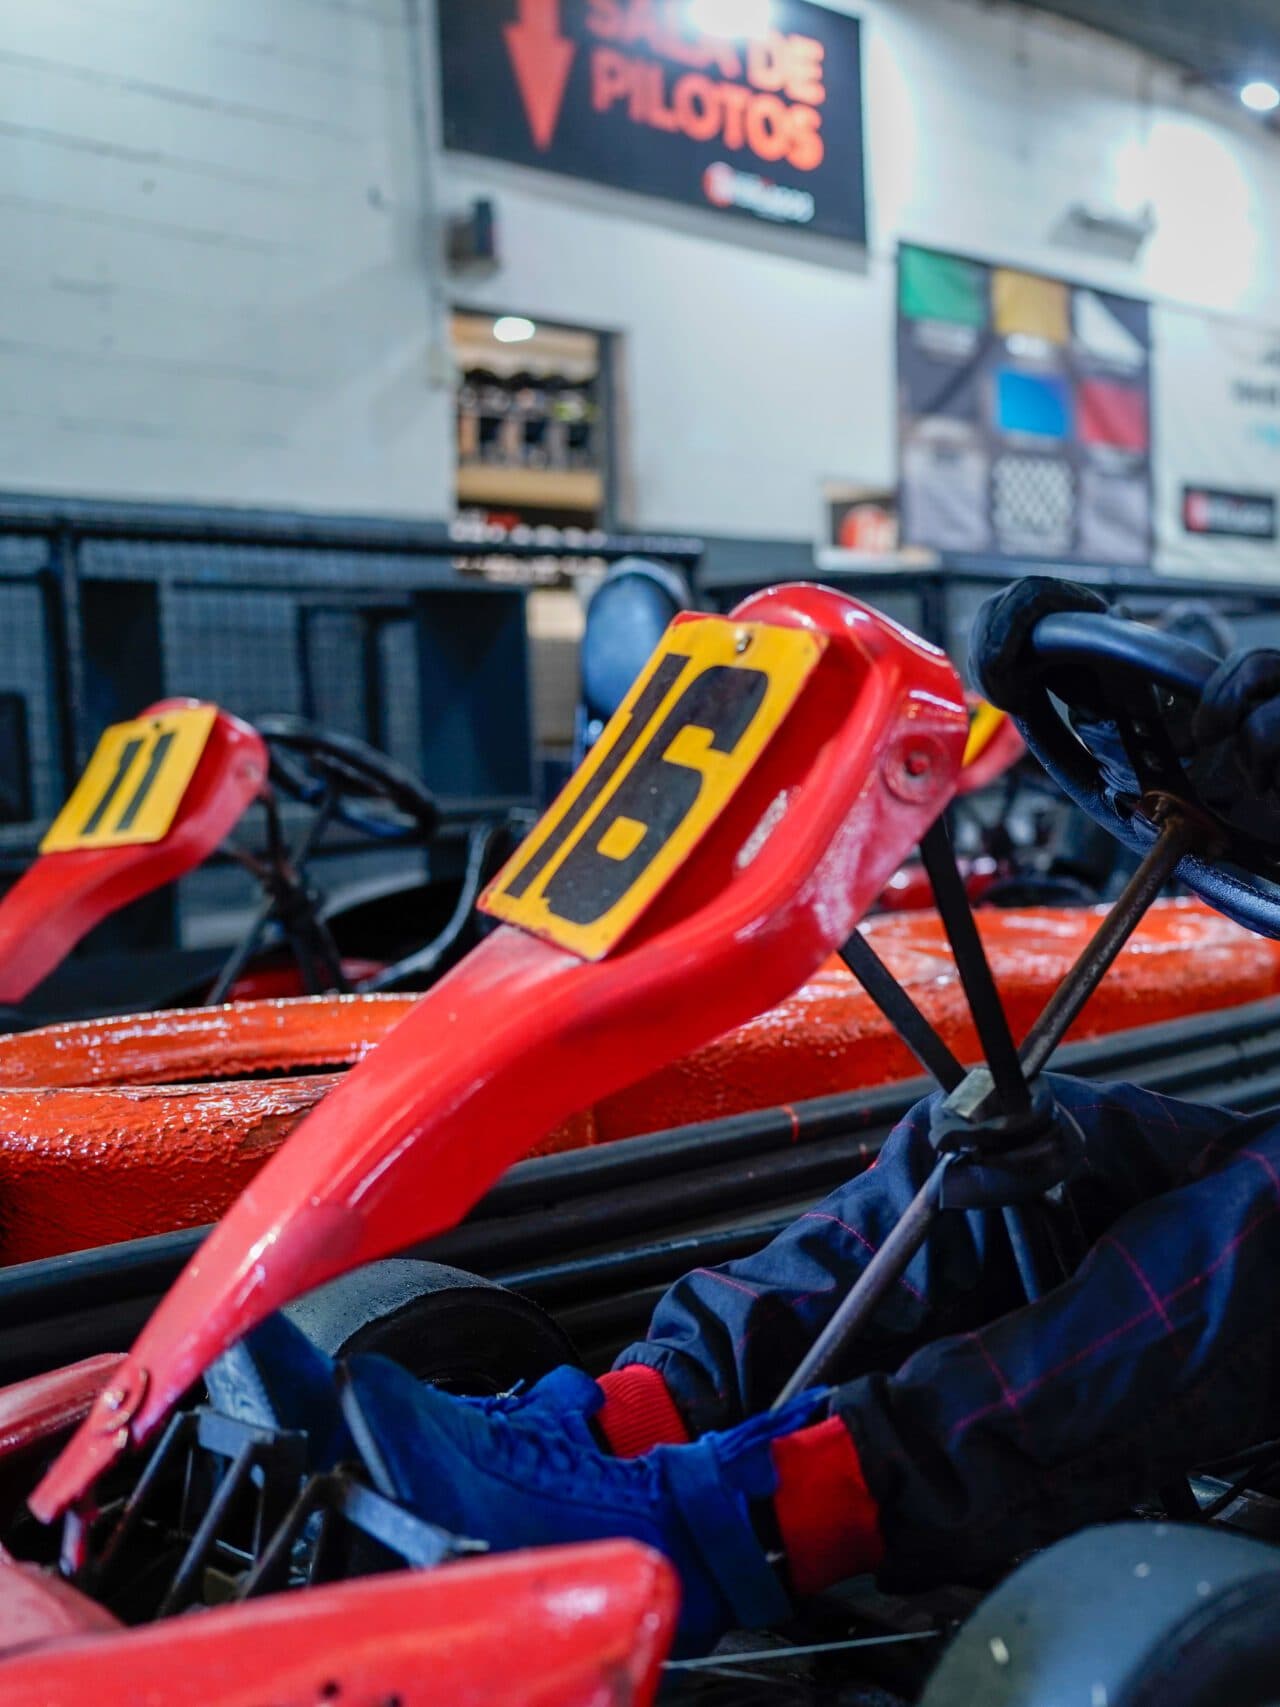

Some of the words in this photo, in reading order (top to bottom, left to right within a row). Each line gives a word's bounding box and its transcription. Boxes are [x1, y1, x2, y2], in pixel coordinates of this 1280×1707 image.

[591, 46, 824, 170] PILOTOS
[746, 29, 825, 105] DE
[79, 730, 178, 836] 11
[503, 652, 770, 926] 16
